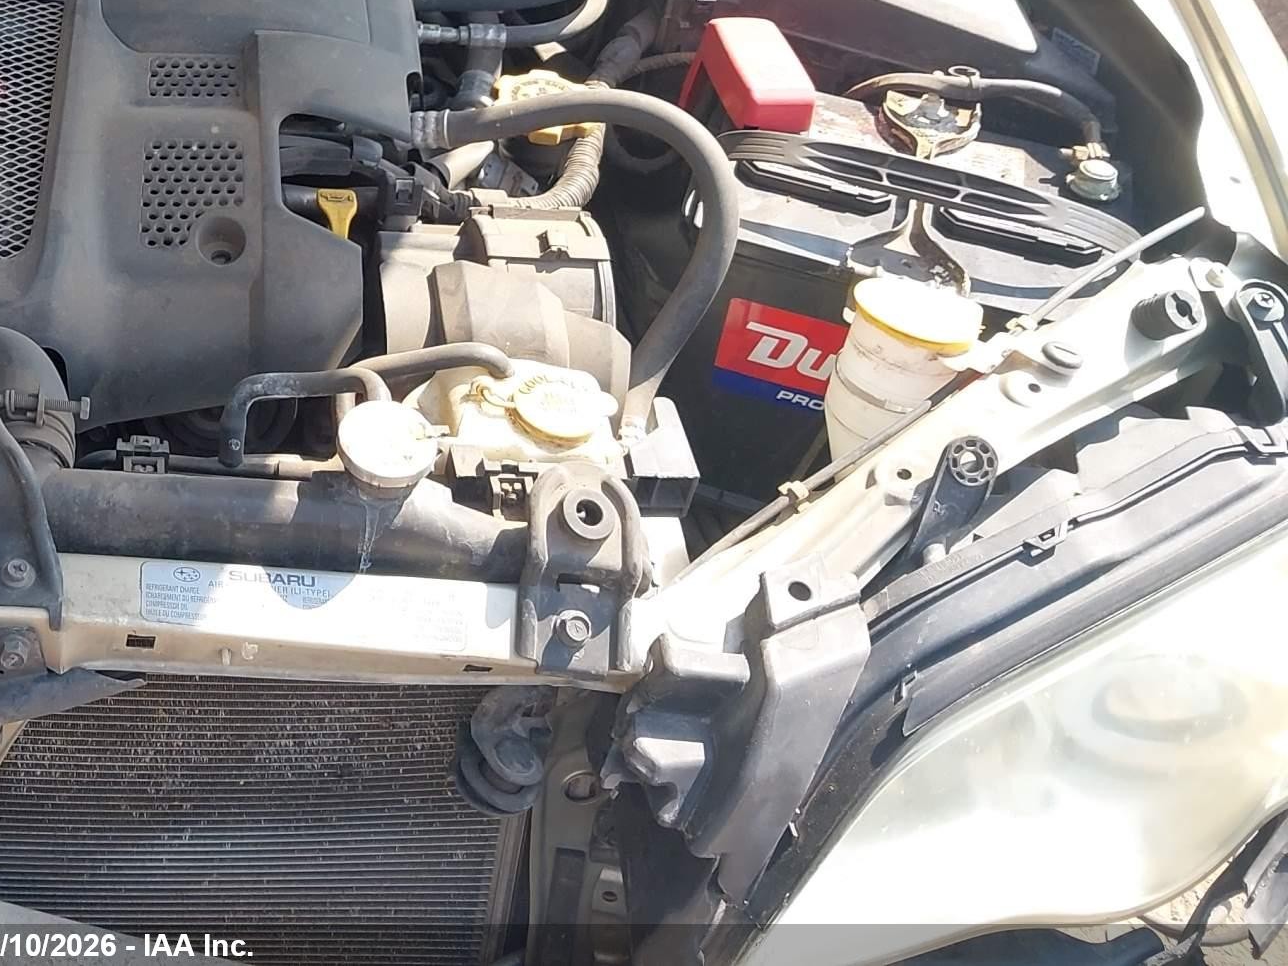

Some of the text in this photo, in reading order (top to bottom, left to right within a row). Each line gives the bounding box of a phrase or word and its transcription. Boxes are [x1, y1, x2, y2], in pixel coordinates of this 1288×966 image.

[746, 321, 837, 382] Du
[776, 390, 825, 411] PRO
[228, 569, 316, 588] SUBARU
